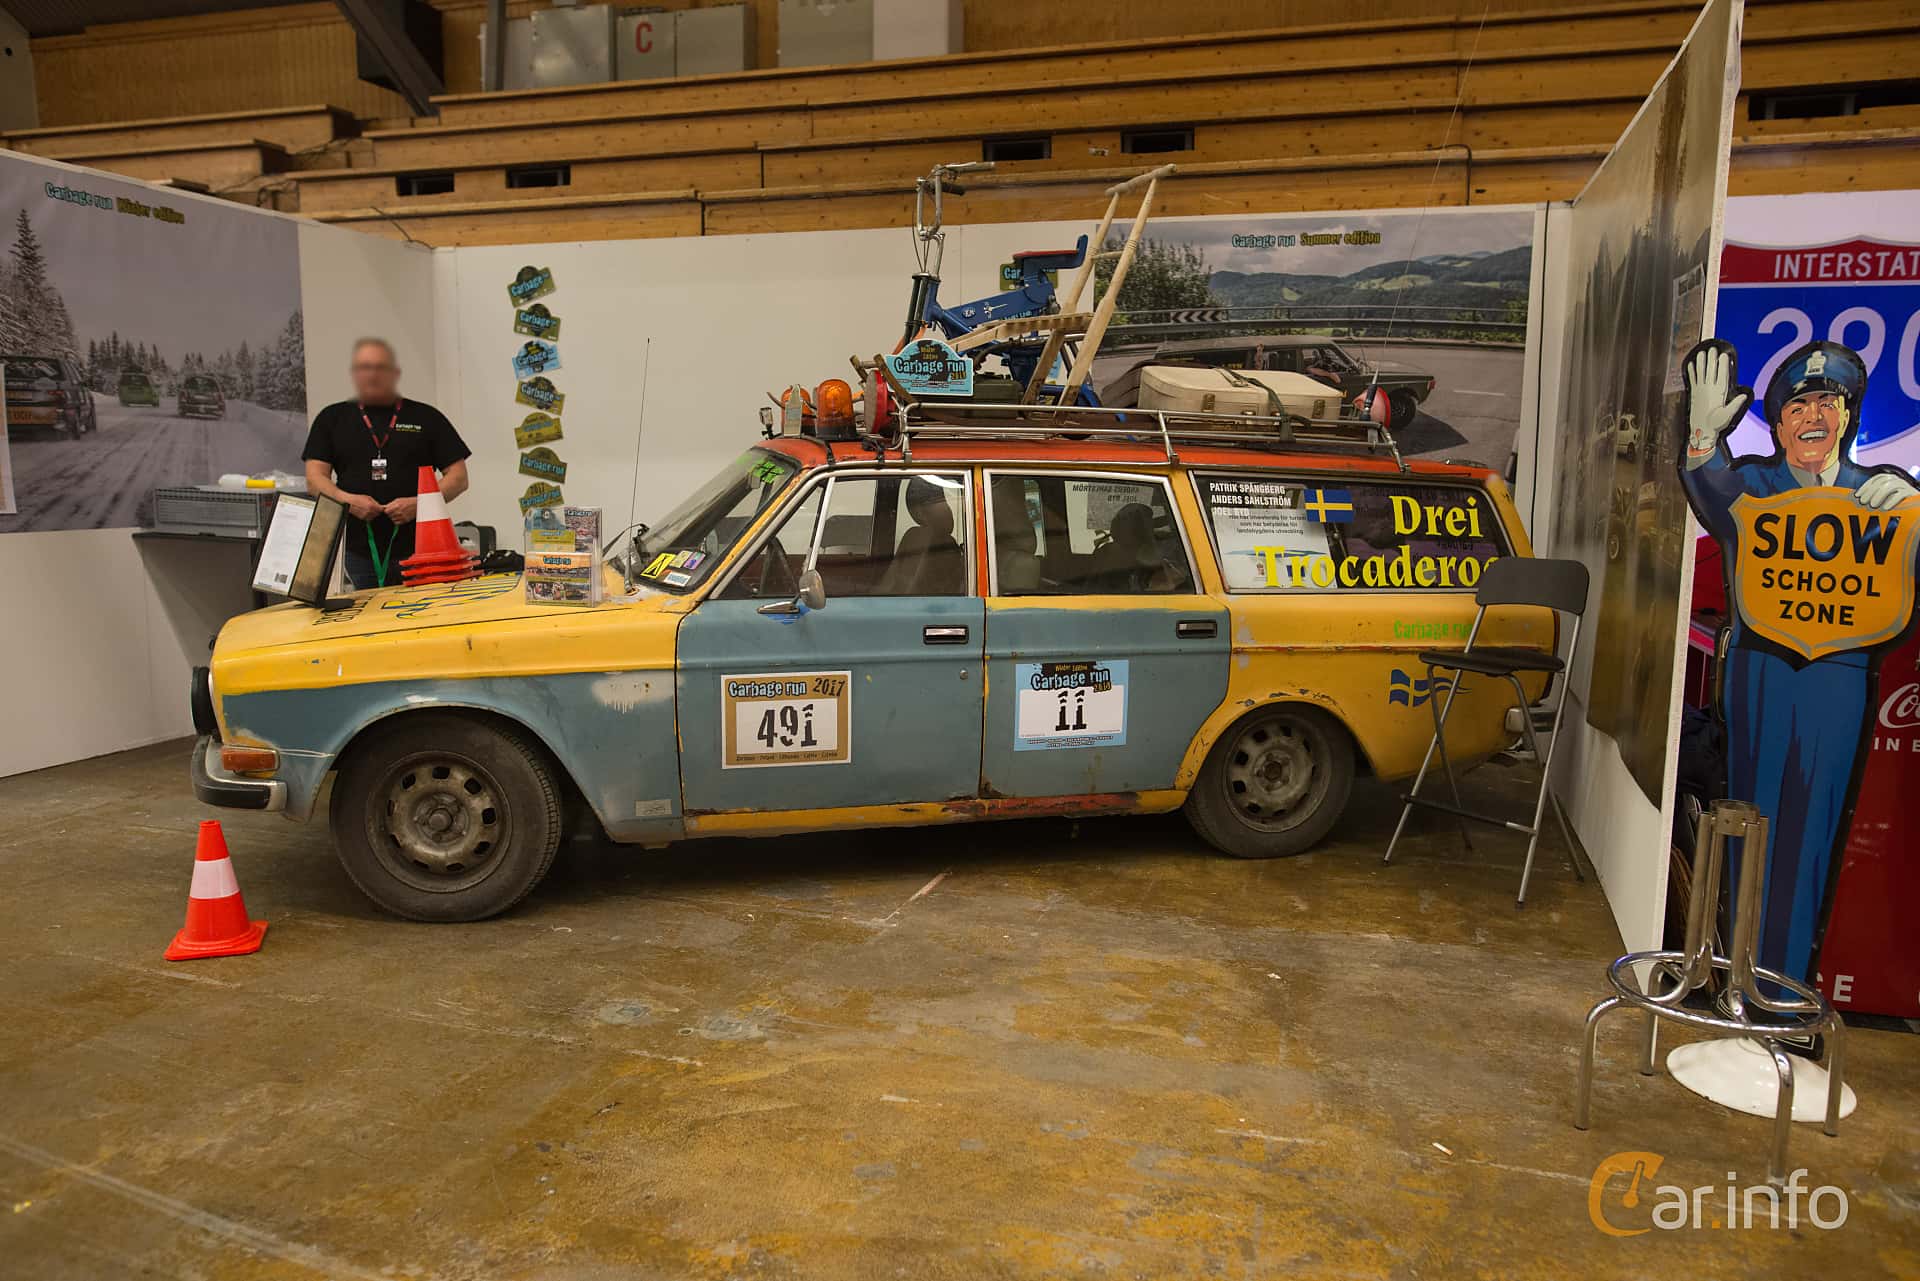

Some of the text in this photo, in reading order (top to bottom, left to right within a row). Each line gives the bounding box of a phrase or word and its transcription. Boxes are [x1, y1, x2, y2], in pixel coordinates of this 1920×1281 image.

[635, 21, 652, 53] C
[1232, 230, 1381, 248] Carbage run Summer edition
[894, 357, 966, 375] Carbage run
[1209, 482, 1239, 493] PATRIK
[1211, 494, 1292, 506] ANDERS SAHLSTRÖM
[1388, 495, 1484, 538] Drei
[1752, 513, 1900, 565] SLOW
[1253, 544, 1500, 588] Trocadero
[1761, 568, 1881, 597] SCHOOL
[1779, 600, 1856, 626] ZONE
[1394, 620, 1449, 640] Carbage
[728, 677, 846, 698] Carbage run 2017
[1031, 669, 1110, 691] Carbage run
[1055, 690, 1087, 731] 11
[1879, 683, 1920, 728] Co
[757, 704, 817, 748] 491
[1873, 737, 1900, 751] IN
